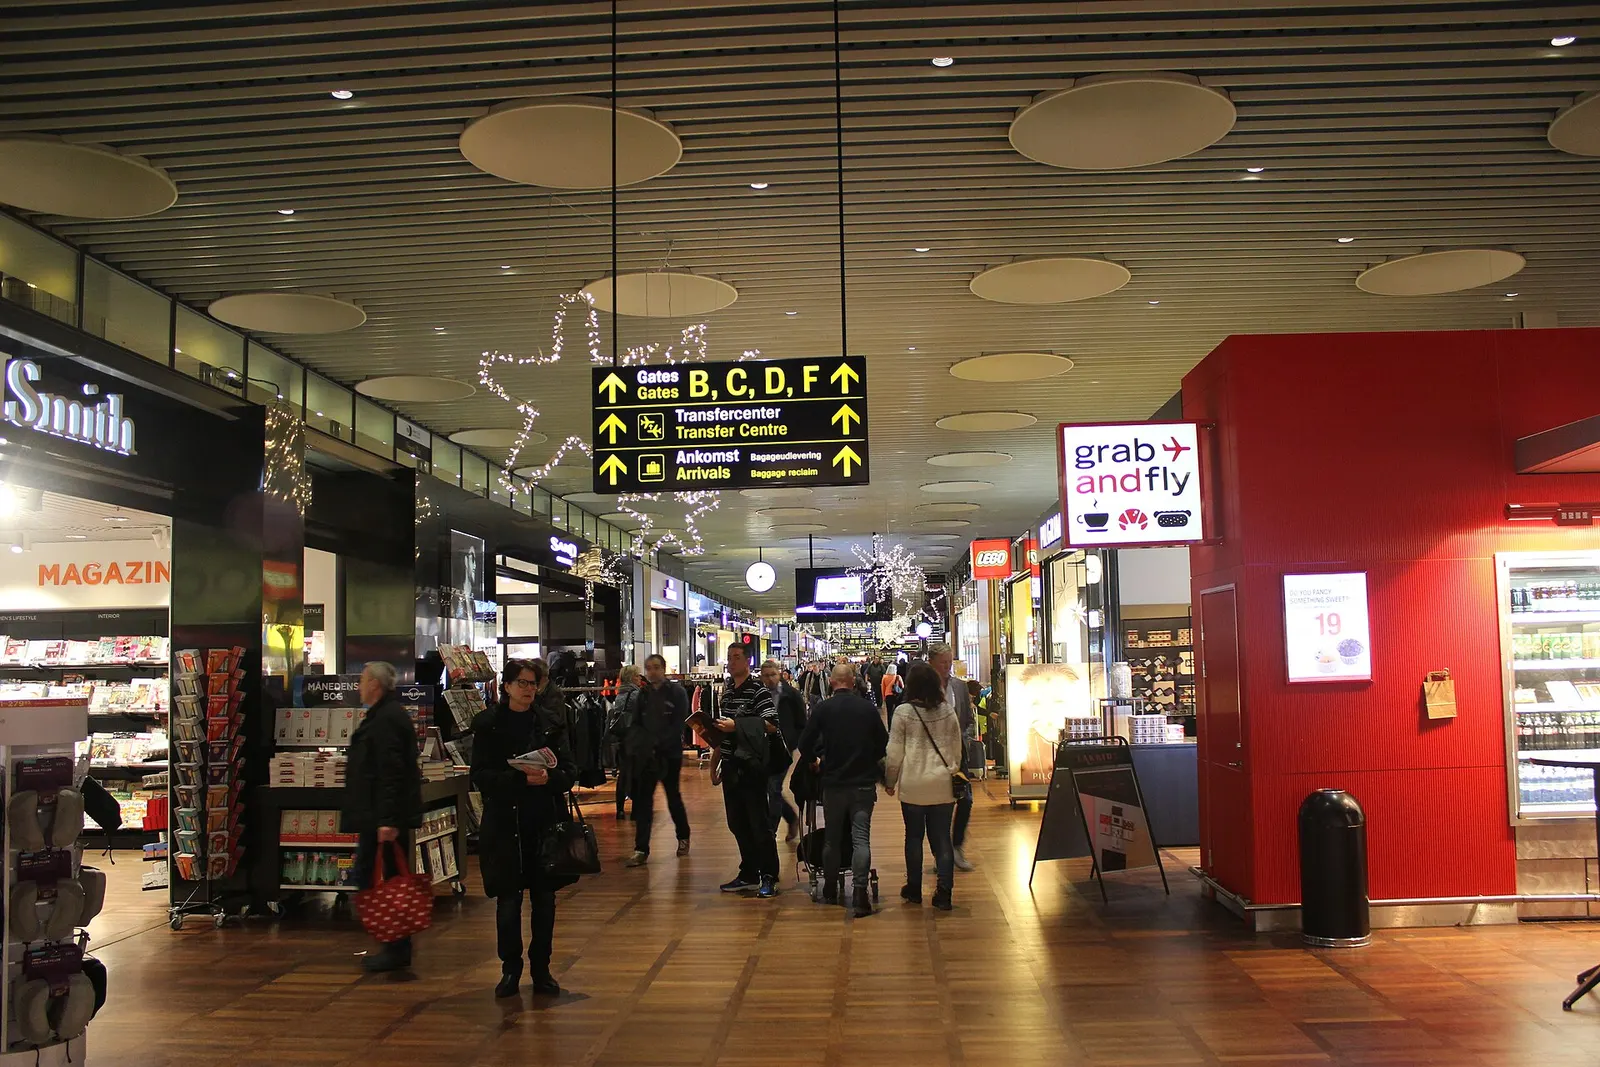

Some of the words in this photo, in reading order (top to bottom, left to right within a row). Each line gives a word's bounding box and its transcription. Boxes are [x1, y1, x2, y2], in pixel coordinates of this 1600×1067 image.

[637, 370, 679, 385] Gates
[689, 370, 718, 401] B,
[726, 368, 755, 399] C,
[764, 366, 793, 398] D,
[803, 365, 820, 393] F
[637, 385, 679, 400] Gates
[675, 406, 781, 423] Transfercenter
[676, 424, 735, 440] Transfer
[739, 423, 788, 438] Centre
[676, 449, 740, 465] Ankomst
[750, 451, 822, 462] Bagageudlevering
[1075, 438, 1156, 469] grab
[676, 466, 731, 481] Arrivals
[750, 469, 786, 479] Baggage
[788, 467, 818, 477] reclaim
[976, 551, 1008, 567] LEGO
[1315, 613, 1342, 636] 19
[307, 681, 360, 691] MÅNEDENS
[323, 692, 344, 701] BOG
